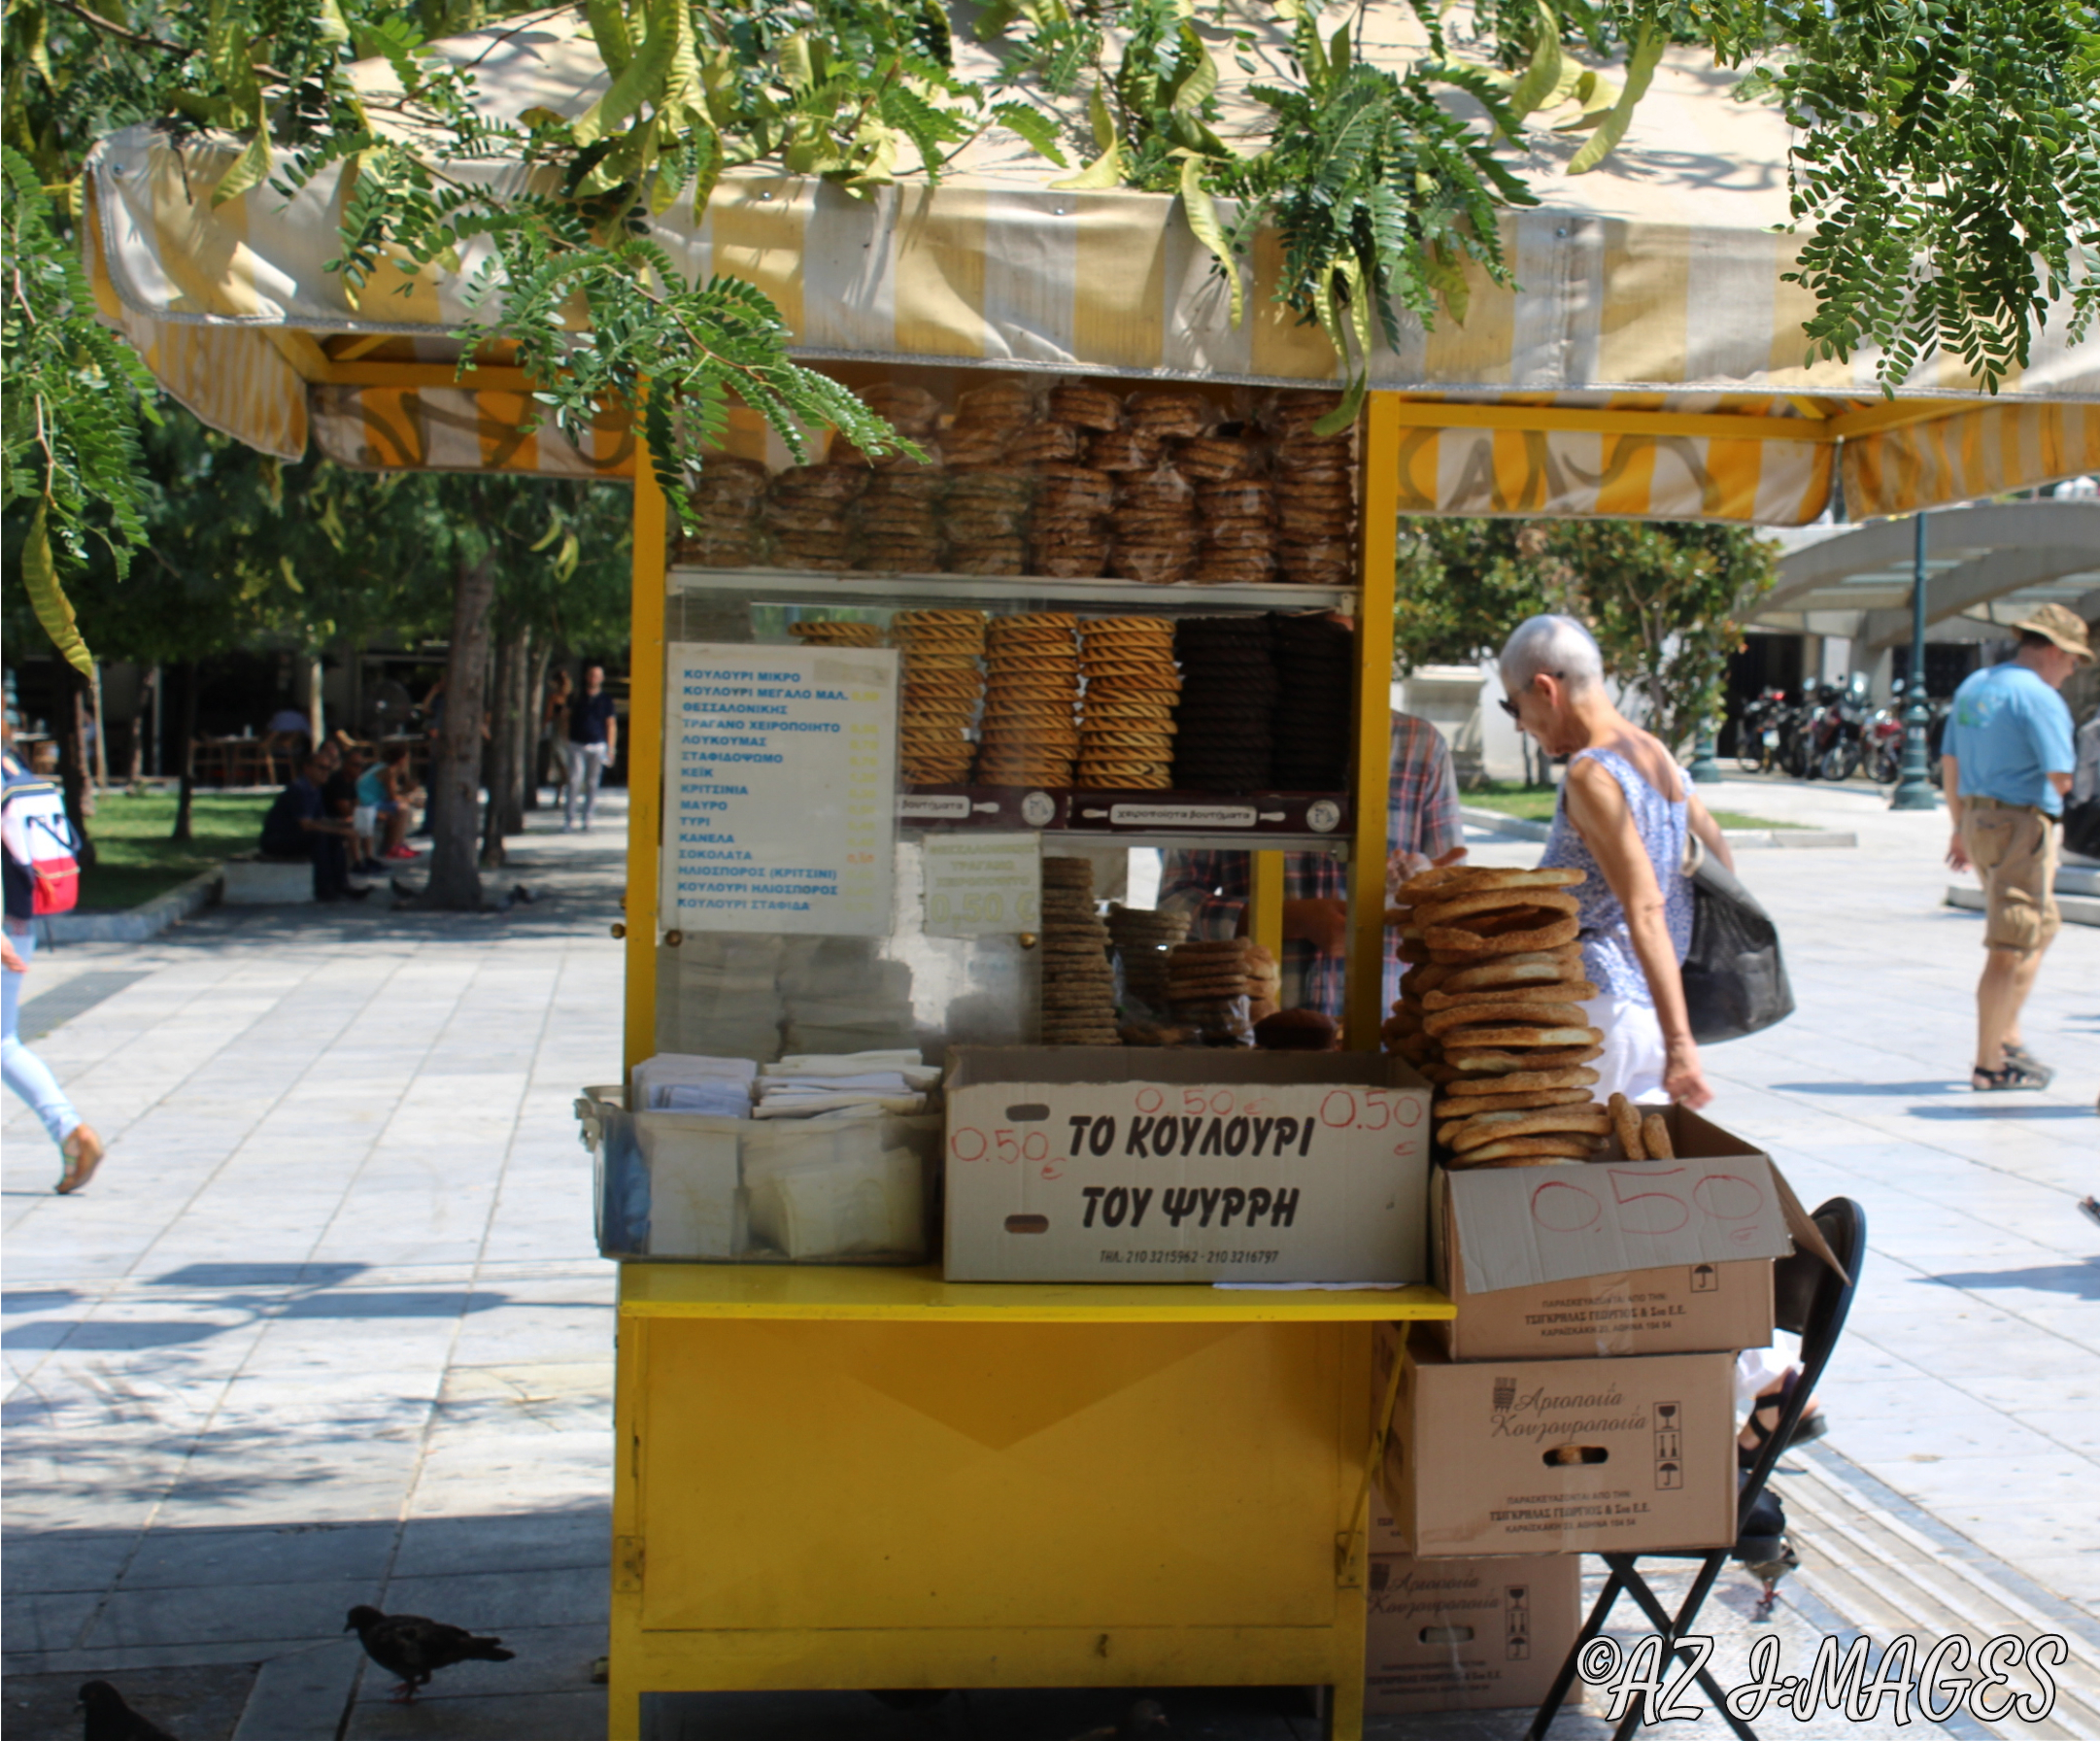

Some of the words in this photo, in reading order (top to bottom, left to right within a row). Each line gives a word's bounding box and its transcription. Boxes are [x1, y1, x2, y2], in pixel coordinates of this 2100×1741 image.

[683, 668, 753, 680] ΚΟΥΛΟΥΡΙ
[758, 671, 801, 683] ΜΙΚΡΟ
[683, 685, 753, 698] ΚΟΥΛΟΥΡΙ
[758, 688, 812, 700] ΜΕΓΑΛΟ
[682, 701, 788, 715] ΘΕΣΣΑΛΟΝΙΚΗΣ
[682, 718, 745, 731] ΤΡΑΓΑΝΟ
[749, 721, 841, 734] ΧΕΙΡΟΠΟΙΗΤΟ
[682, 734, 767, 747] ΛΟΥΚΟΥΜΑΣ
[682, 750, 784, 764] ΣΤΑΦΙΔΟΨΩΜΟ
[680, 783, 749, 796] ΚΡΙΤΣΙΝΙΑ
[680, 800, 728, 811] ΜΑΥΡΟ
[679, 815, 711, 827] ΤΥΡΙ
[679, 833, 735, 844] ΚΑΝΕΛΑ
[678, 848, 753, 861] ΣΟΚΟΛΑΤΑ
[678, 865, 765, 877] ΗΛΙΟΣΠΟΡΟΣ
[769, 868, 838, 881] (ΚΡΙΤΣΙΝΙ)
[677, 881, 748, 893] ΚΟΥΛΟΥΡΙ
[751, 884, 838, 896] ΗΛΙΟΣΠΟΡΟΣ
[676, 898, 747, 909] ΚΟΥΛΟΥΡΙ
[751, 900, 810, 911] ΣΤΑΦΙΔΑ
[930, 892, 1004, 929] 0,50
[1320, 1089, 1422, 1131] 0.50
[1067, 1114, 1116, 1157] ΤΟ
[1125, 1114, 1316, 1159] ΚΟΥΛΟΥΡΙ
[950, 1126, 1049, 1165] 0.50
[1081, 1185, 1154, 1228] ΤΟΥ
[1162, 1186, 1301, 1229] ΨΥΡΡΗ
[1531, 1167, 1764, 1235] 0.50
[1126, 1249, 1148, 1263] 210
[1149, 1249, 1199, 1264] 3215962
[1206, 1249, 1228, 1263] 210
[1230, 1249, 1280, 1264] 3216797
